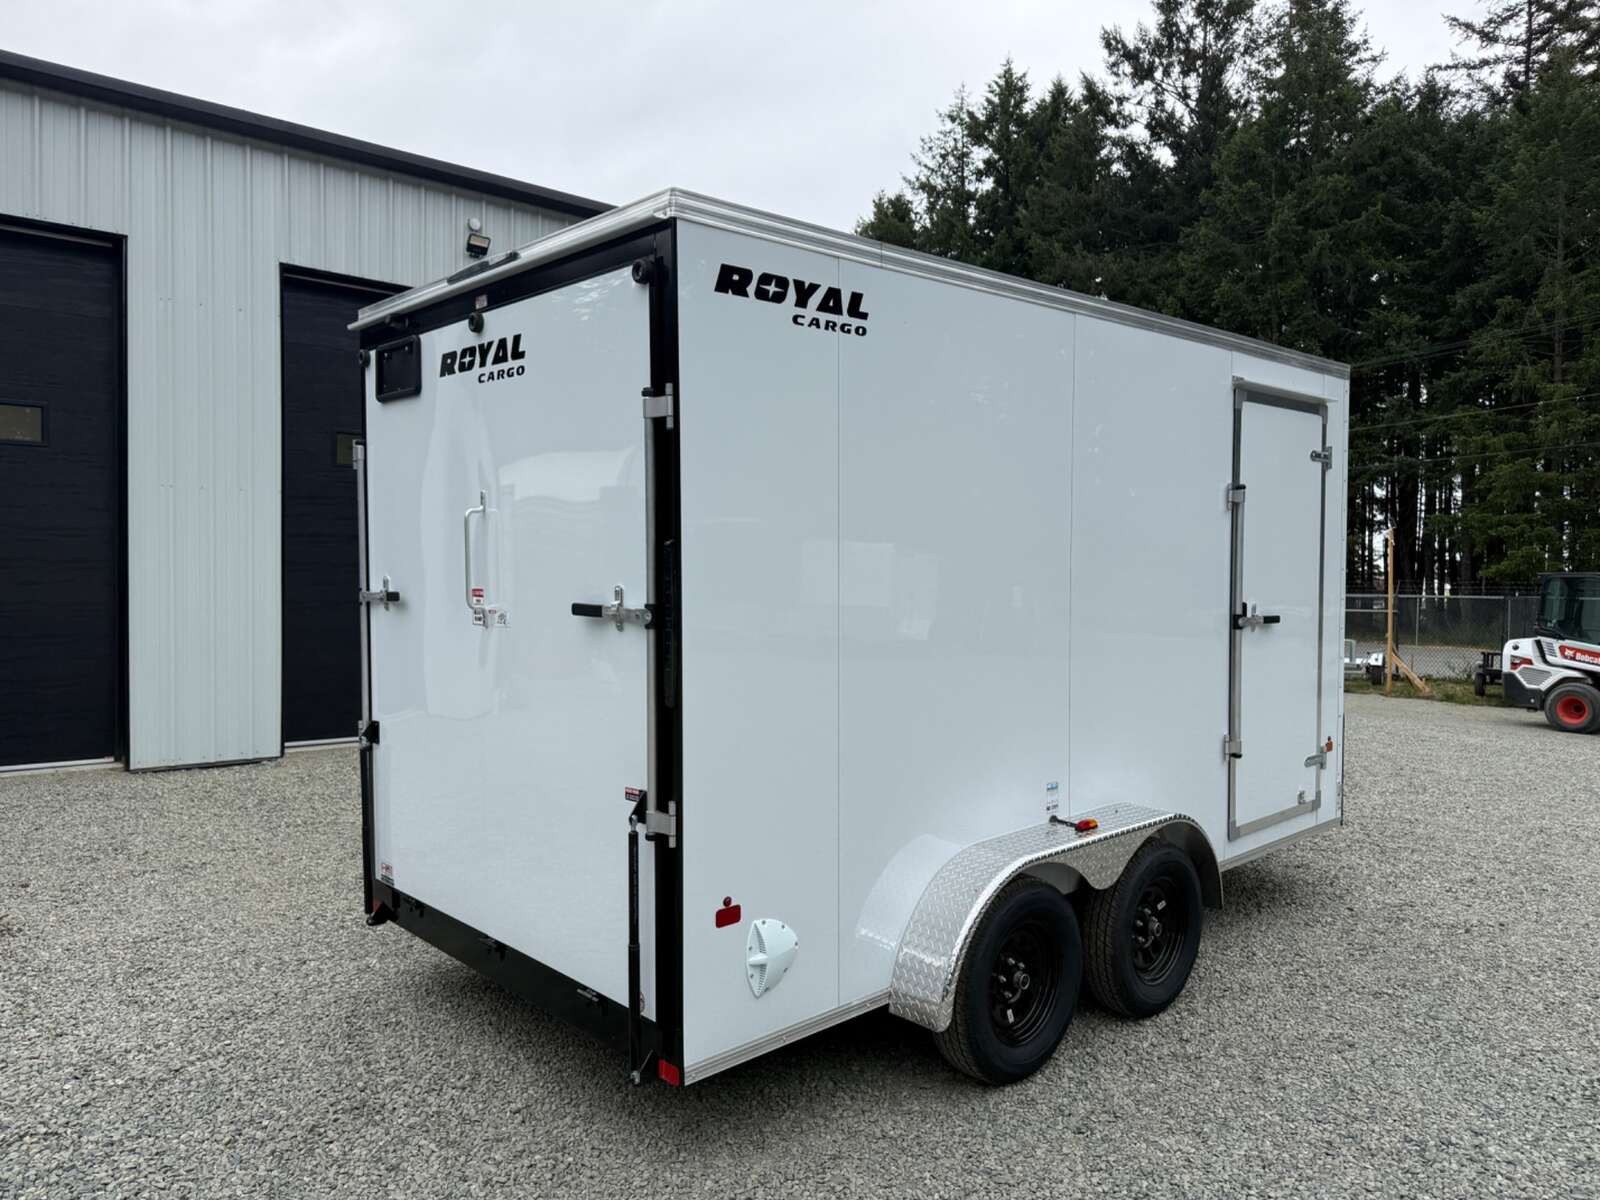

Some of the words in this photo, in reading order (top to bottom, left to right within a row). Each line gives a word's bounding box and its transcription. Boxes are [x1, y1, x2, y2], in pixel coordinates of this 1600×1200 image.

[714, 263, 869, 320] ROYAL
[792, 314, 867, 337] CARGO
[439, 333, 526, 378] ROYAL
[478, 365, 525, 384] CARGO
